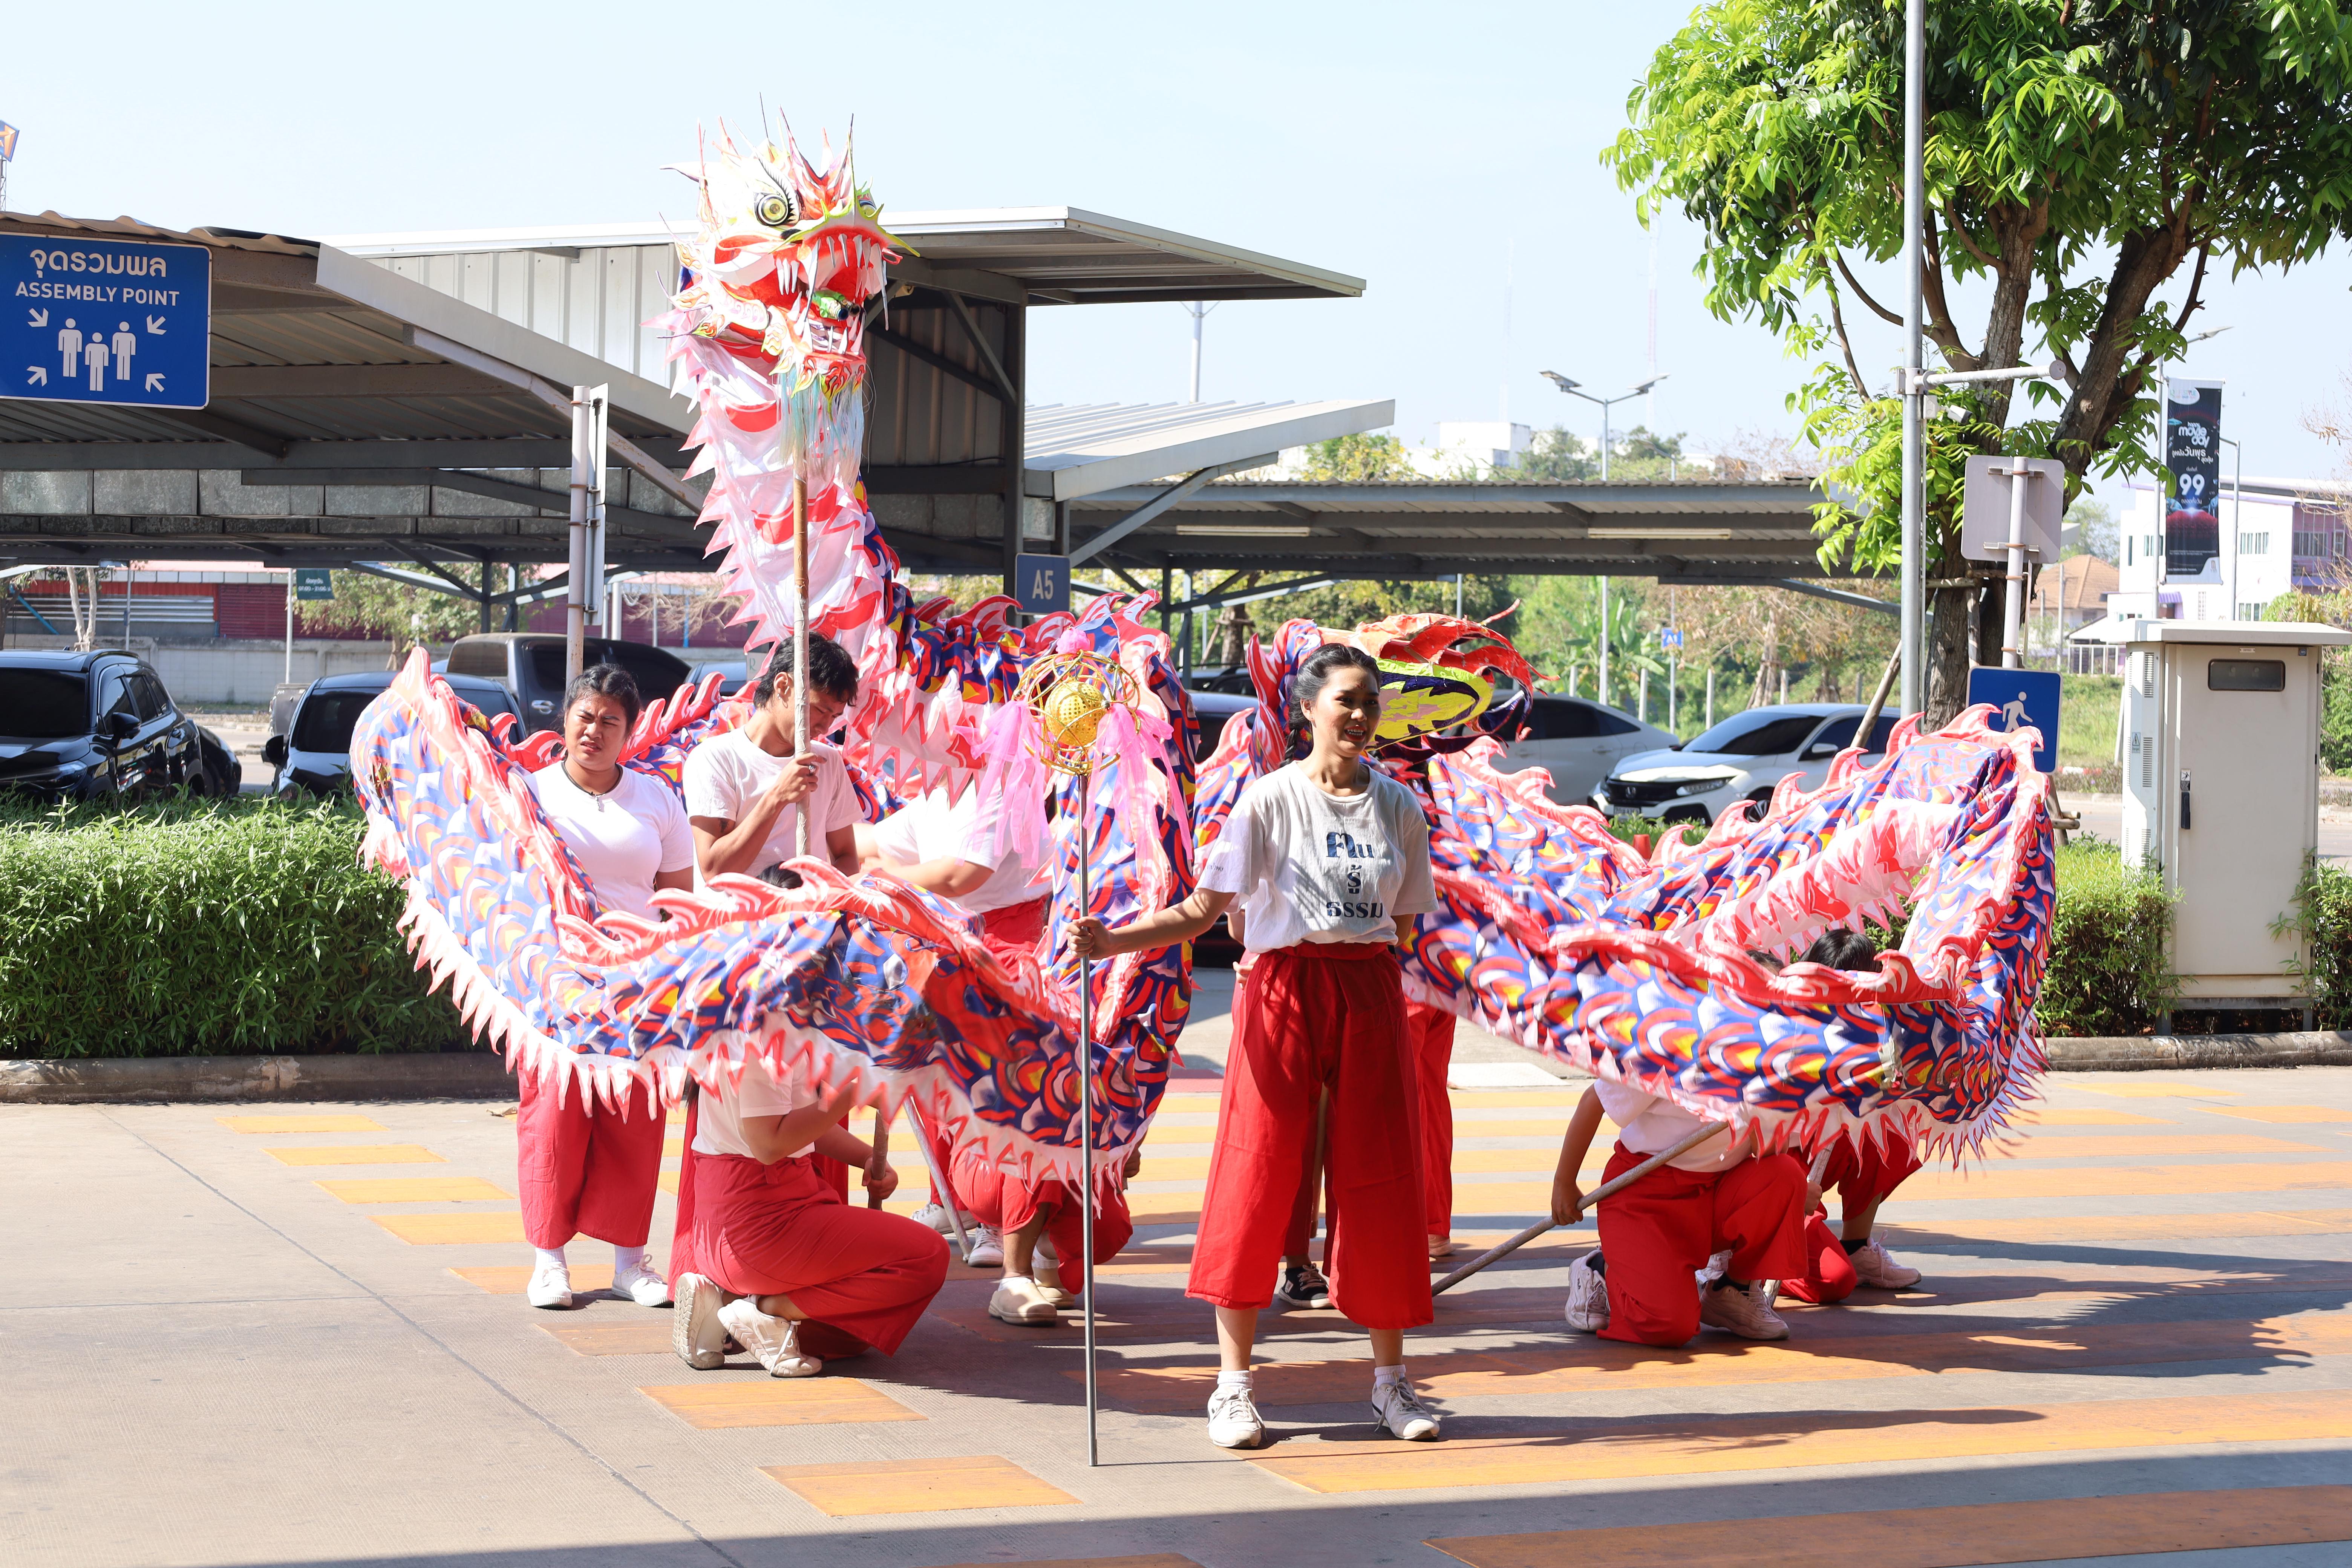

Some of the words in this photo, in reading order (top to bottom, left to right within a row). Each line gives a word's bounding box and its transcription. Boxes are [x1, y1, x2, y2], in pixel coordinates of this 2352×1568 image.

[30, 249, 166, 278] จุดรวมพล
[15, 281, 117, 302] ASSEMBLY
[123, 288, 180, 306] POINT
[2178, 426, 2207, 437] movie
[2191, 435, 2210, 448] day
[2179, 473, 2205, 496] 99
[1032, 569, 1054, 600] A5
[1326, 902, 1383, 919] ธรรม
